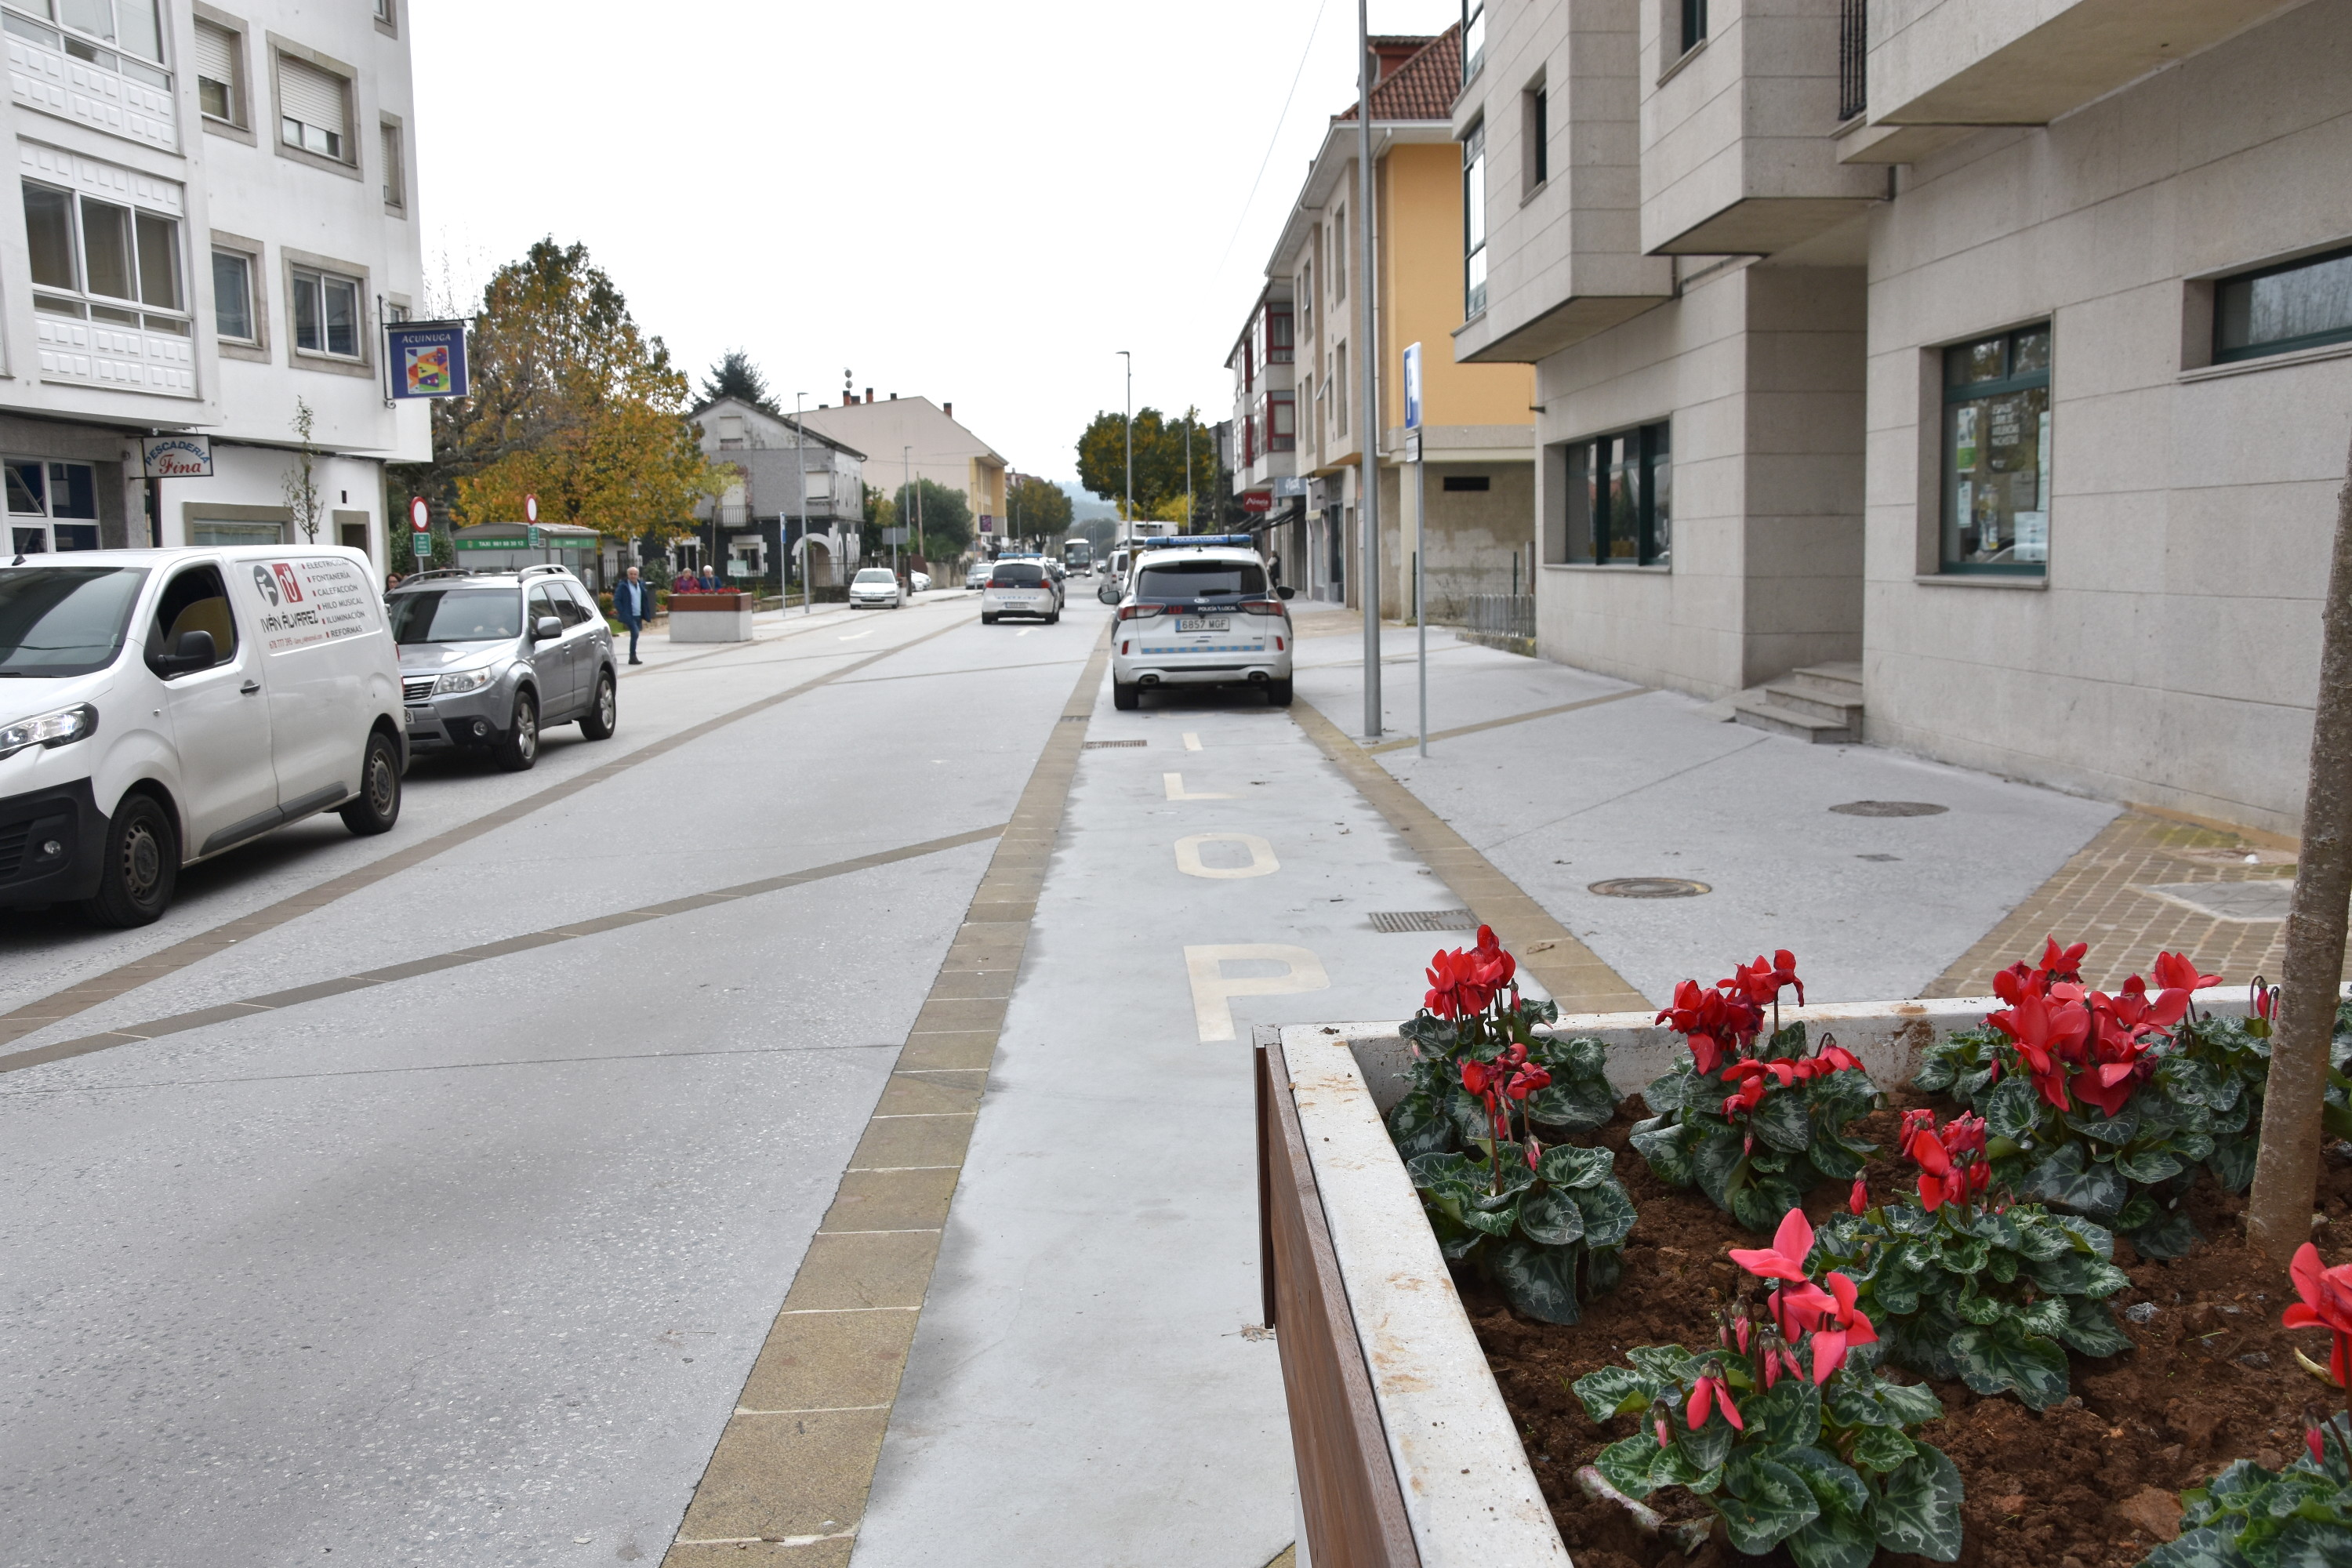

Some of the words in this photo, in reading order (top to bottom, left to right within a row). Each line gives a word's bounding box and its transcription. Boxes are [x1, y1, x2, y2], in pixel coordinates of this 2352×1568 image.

[401, 333, 452, 343] ACUINUGA
[159, 454, 201, 474] Fina
[312, 571, 350, 583] FONTANERÍA
[318, 584, 358, 596] CALEFACCIÓN
[322, 601, 337, 610] HILO
[339, 597, 364, 608] MUSICAL
[1167, 605, 1184, 614] 112
[260, 613, 283, 633] IVÁN
[282, 610, 318, 629] ÁLVAREZ
[326, 611, 365, 624] ILUMINACIÓN
[1181, 619, 1205, 629] 6857
[1208, 619, 1226, 628] MGF
[330, 625, 362, 637] REFORMAS
